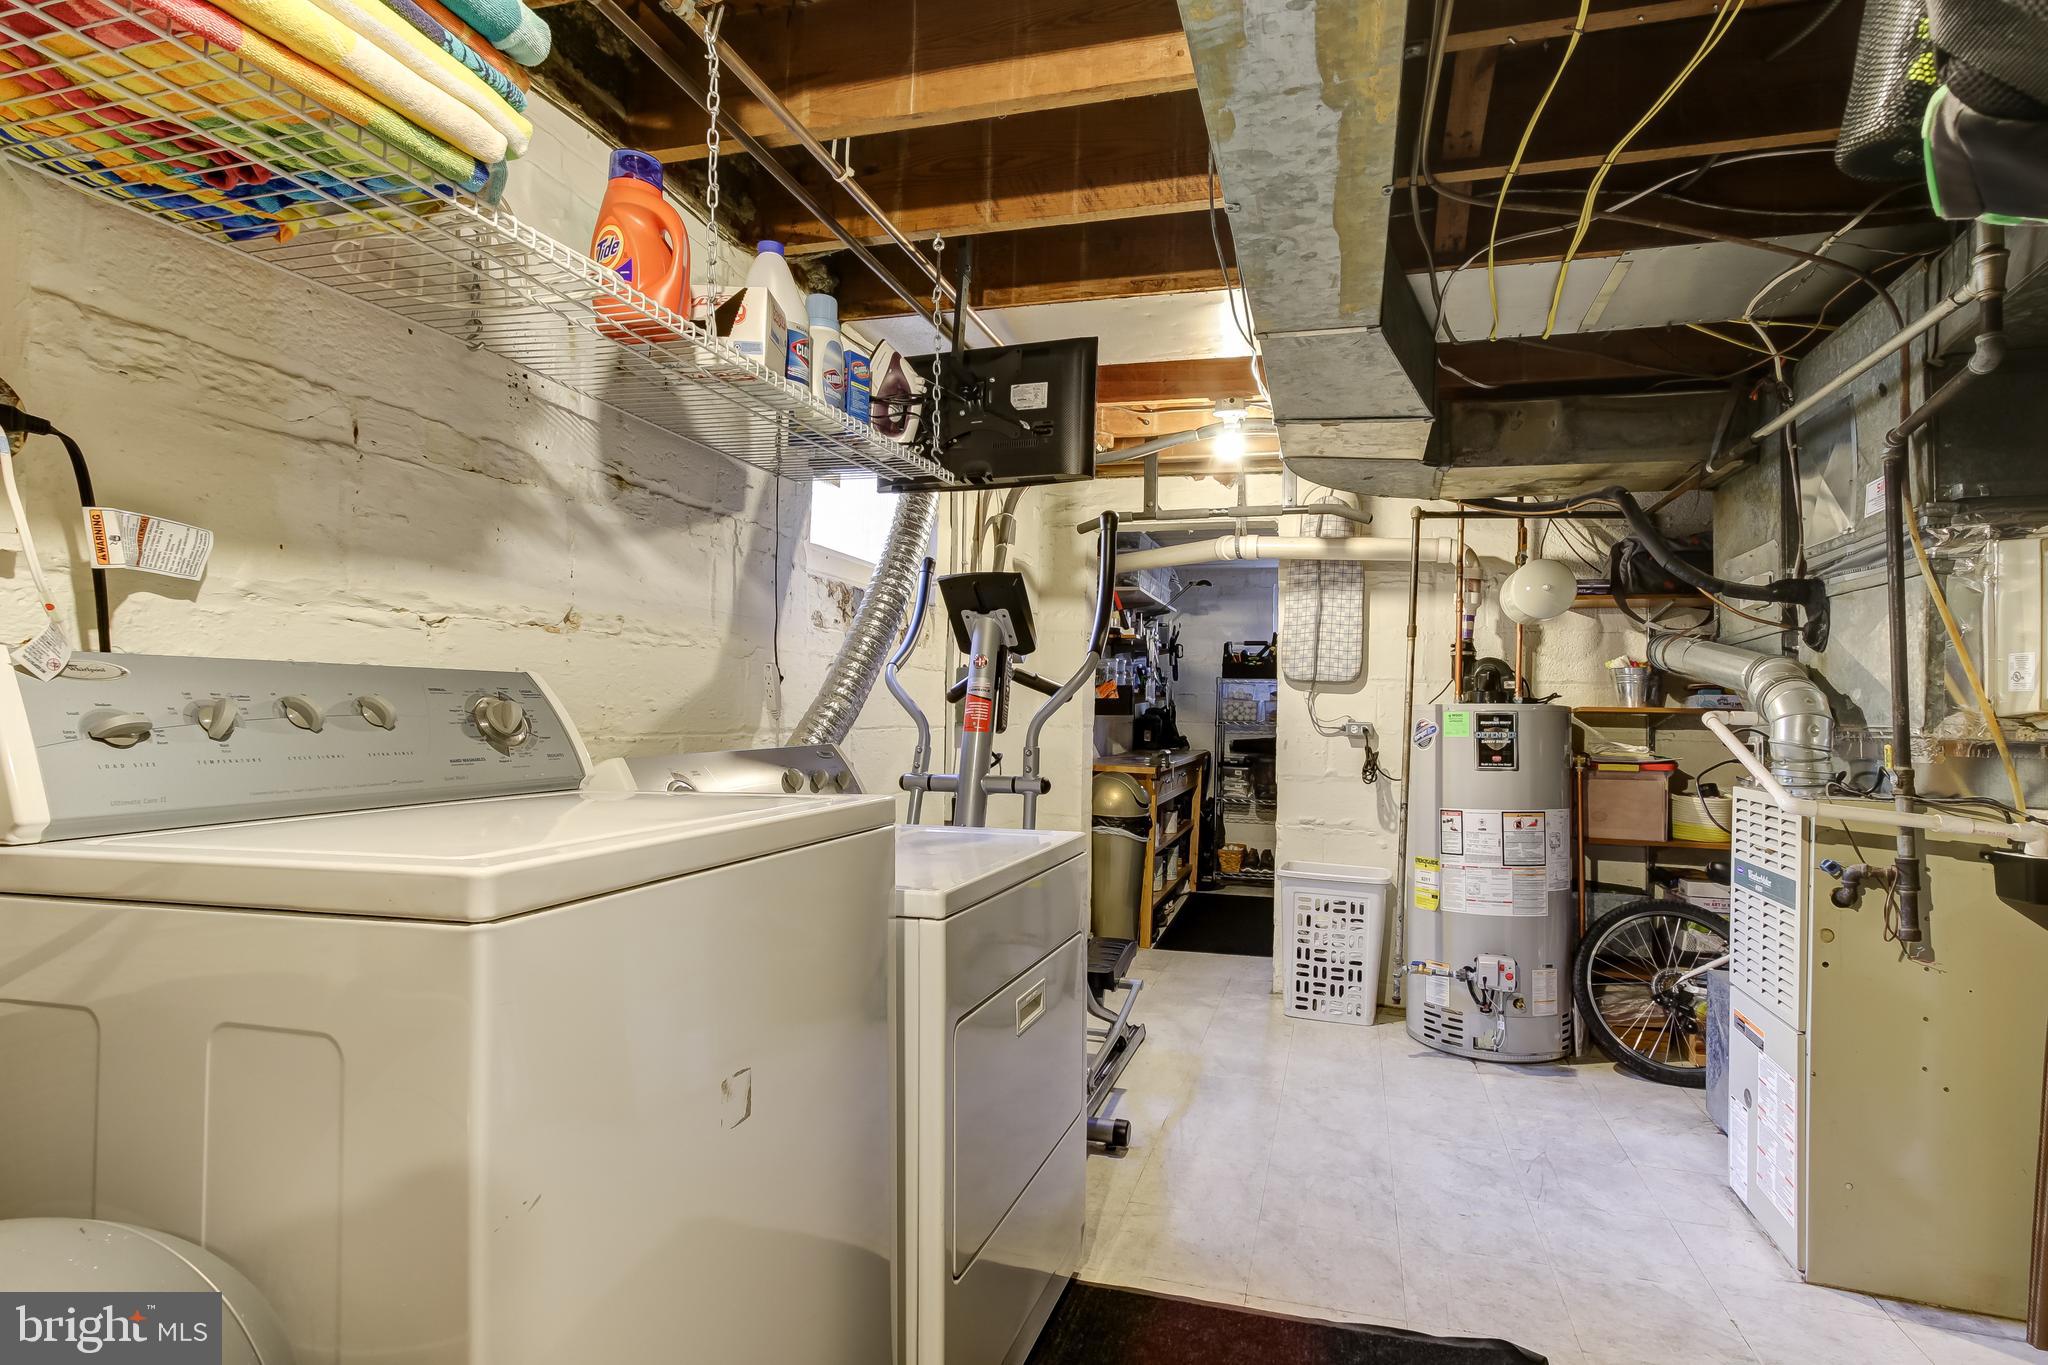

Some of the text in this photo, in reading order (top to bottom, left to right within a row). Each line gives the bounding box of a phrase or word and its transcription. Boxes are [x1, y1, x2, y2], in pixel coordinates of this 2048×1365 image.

[597, 237, 620, 262] Tide
[796, 343, 809, 358] CLO
[92, 513, 107, 556] WARNING
[1475, 731, 1516, 739] DEFENDER
